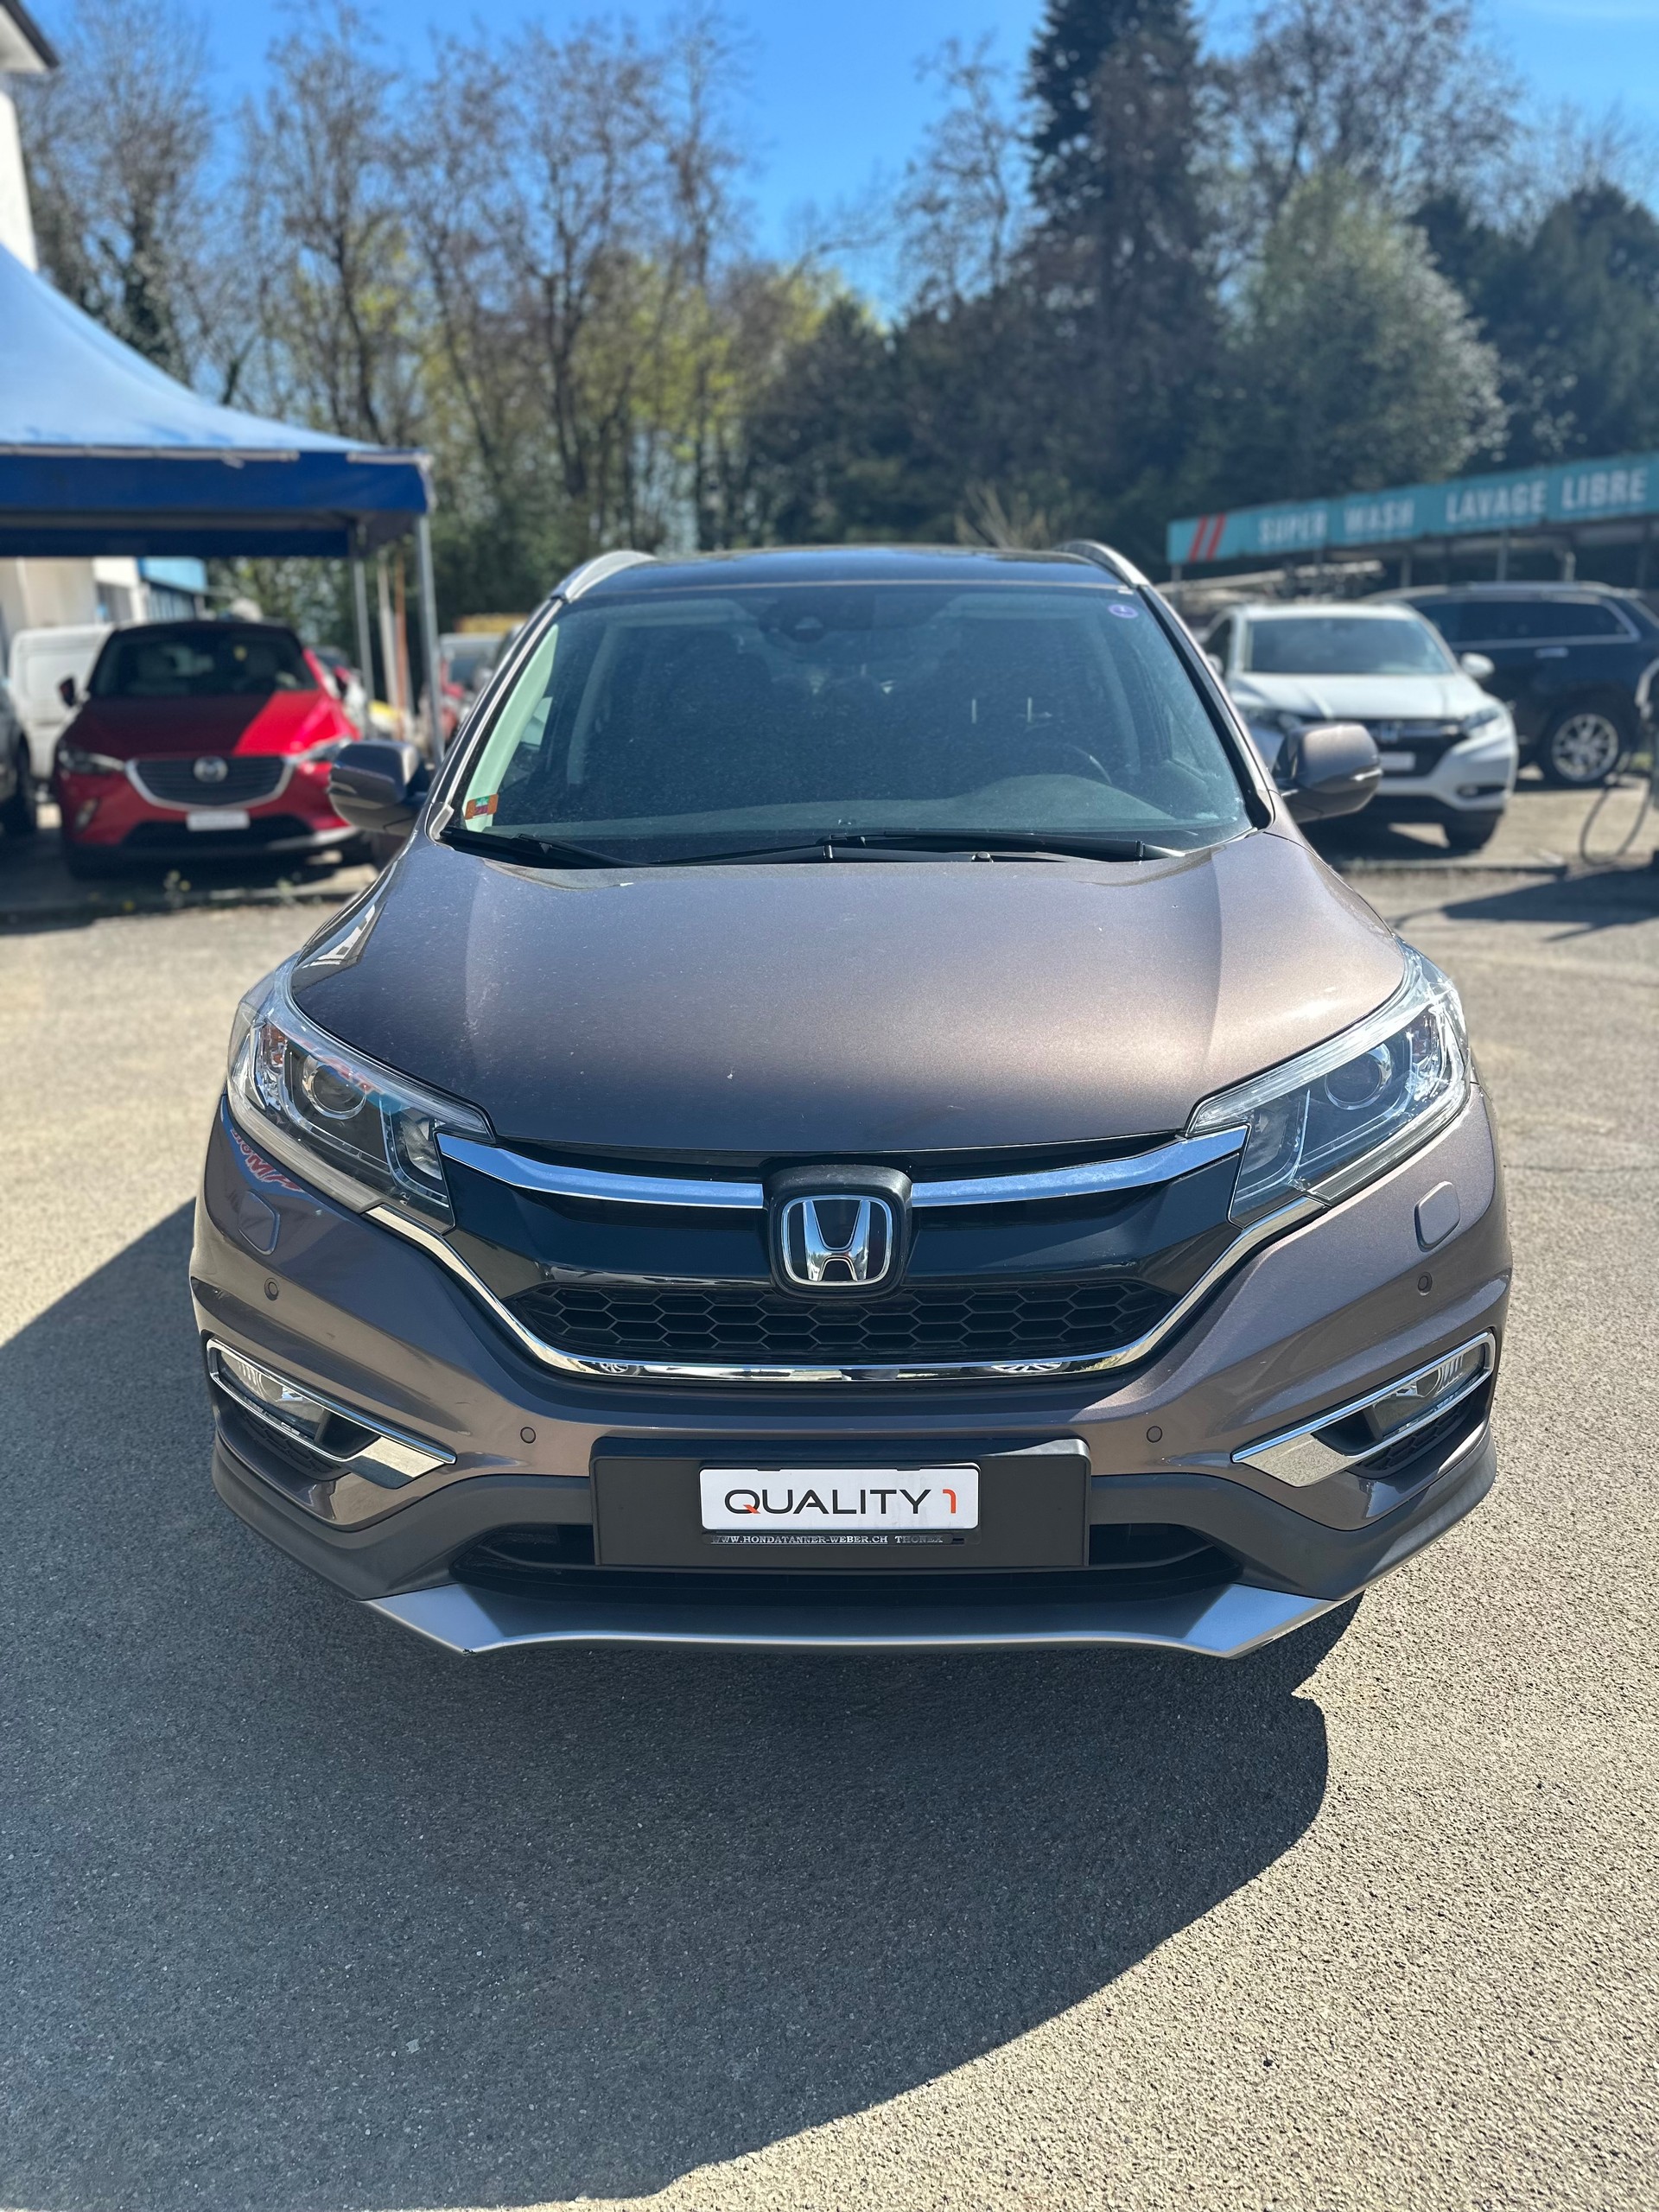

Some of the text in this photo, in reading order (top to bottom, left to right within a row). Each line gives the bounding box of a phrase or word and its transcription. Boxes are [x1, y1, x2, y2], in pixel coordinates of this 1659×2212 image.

[1259, 468, 1648, 545] SUPER WASH LAVAGE LIBRE
[724, 1489, 957, 1515] QUALITY 1
